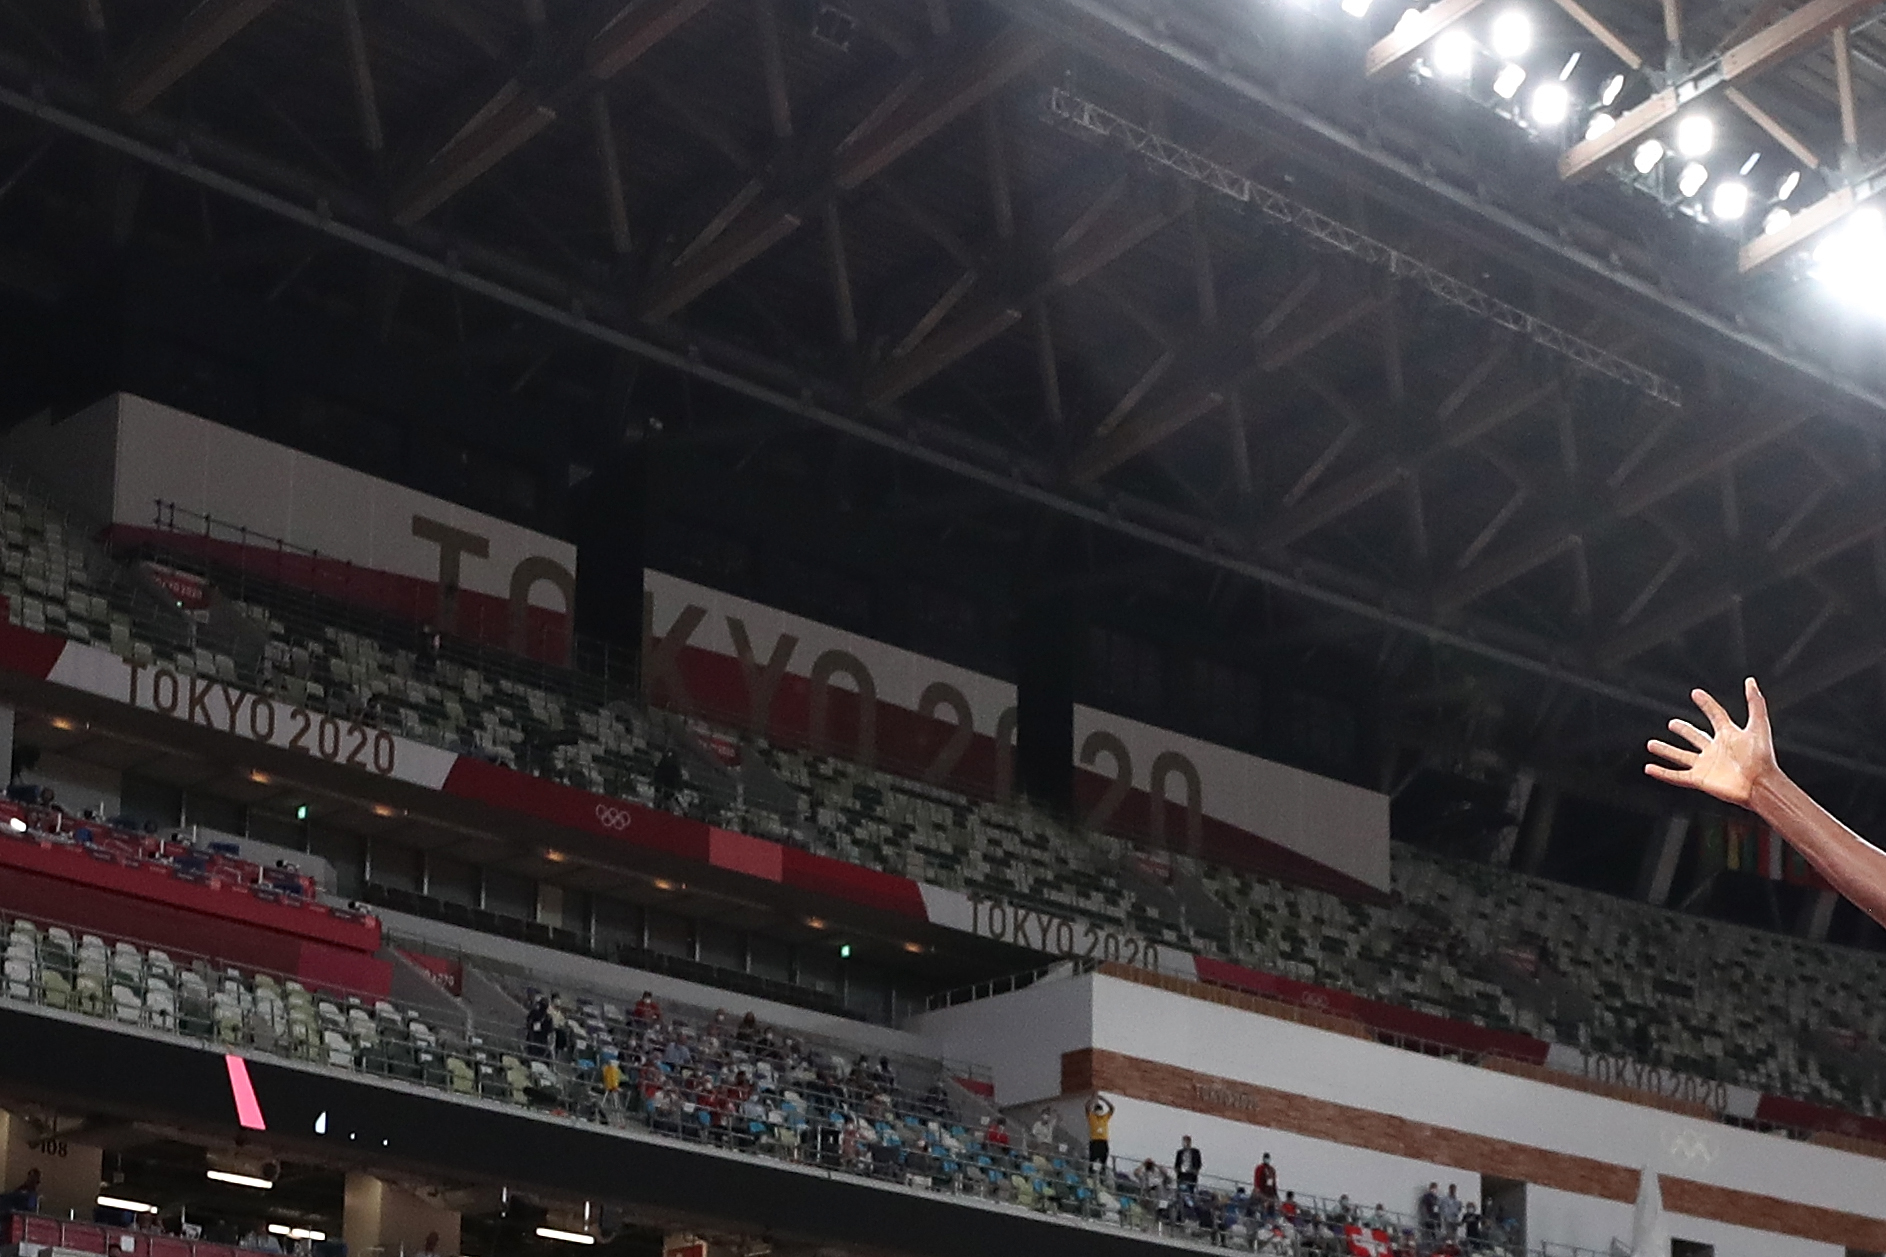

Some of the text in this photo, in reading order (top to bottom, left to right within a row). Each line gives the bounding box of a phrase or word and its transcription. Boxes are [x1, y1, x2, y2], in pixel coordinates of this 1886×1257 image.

[122, 658, 397, 777] TOKYO 2020
[967, 900, 1074, 957] TOKYO
